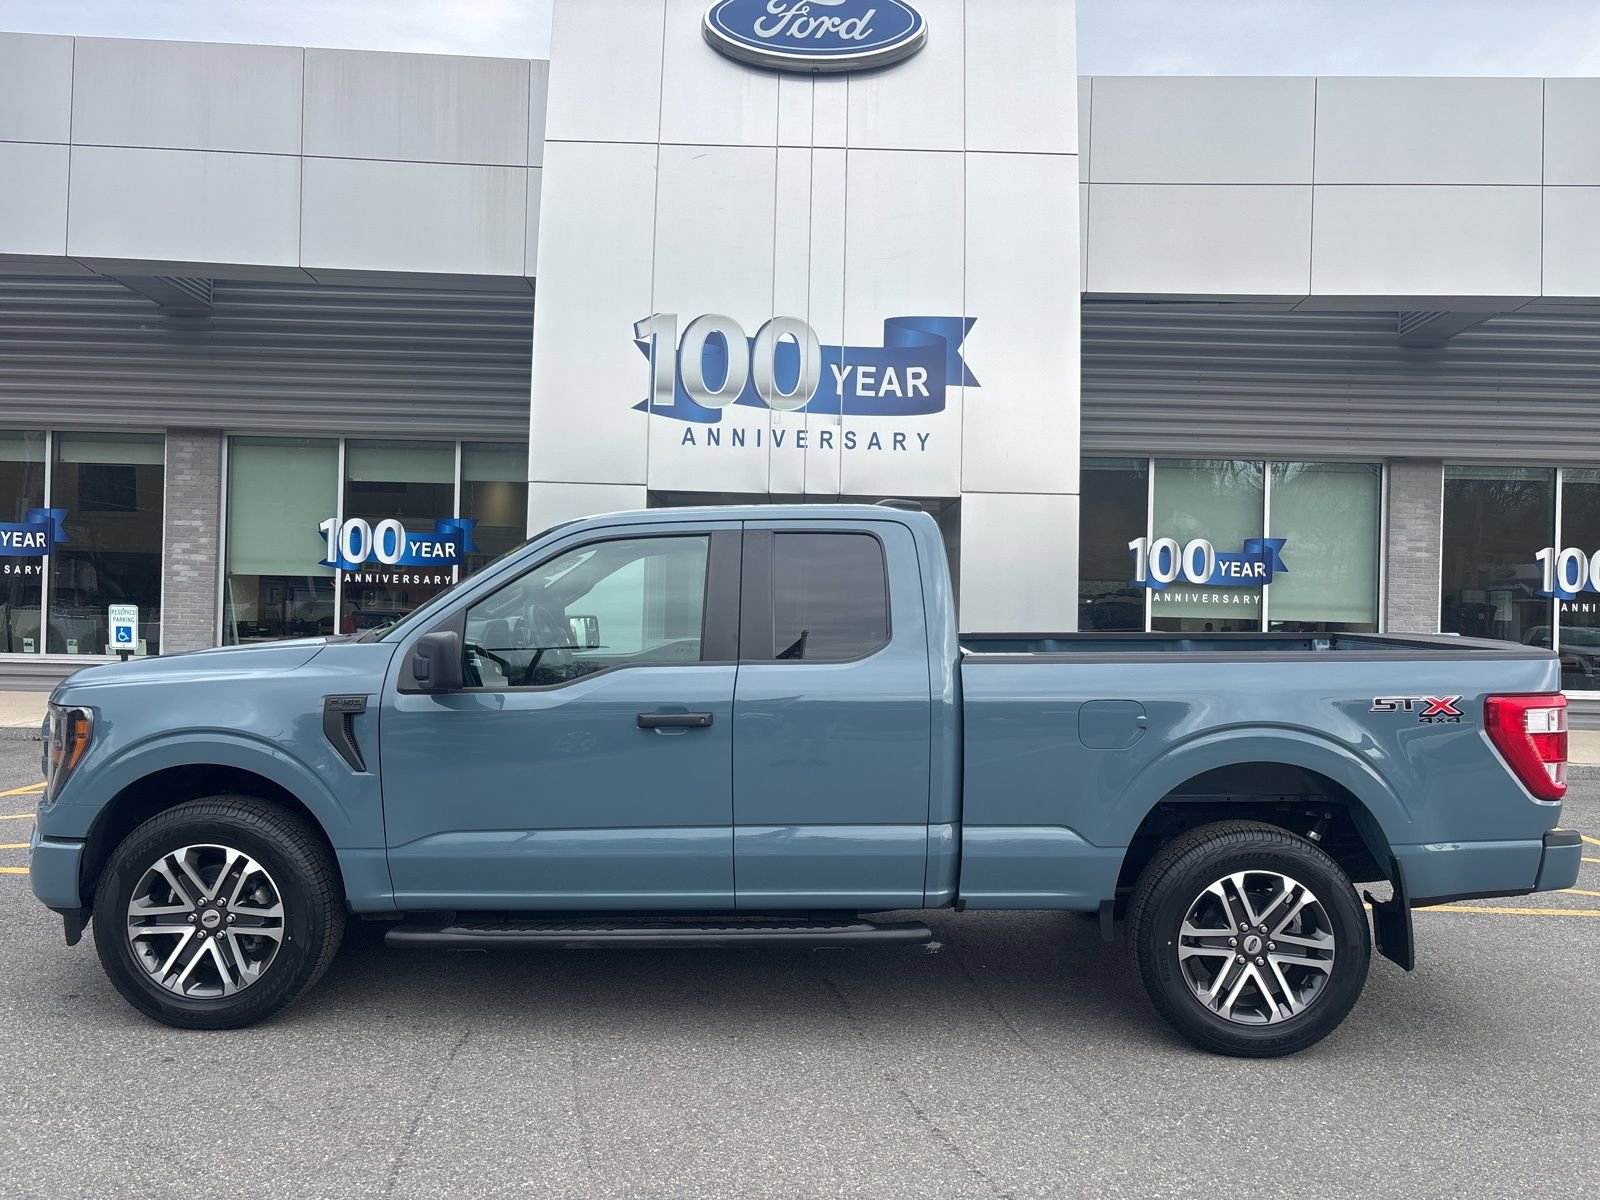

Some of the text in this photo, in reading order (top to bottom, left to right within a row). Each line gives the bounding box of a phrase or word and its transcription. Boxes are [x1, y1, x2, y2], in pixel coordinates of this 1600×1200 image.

[753, 0, 876, 41] Ford
[633, 313, 930, 411] 100 YEAR
[681, 427, 931, 451] ANNIVERSARY
[1, 531, 46, 547] YEAR
[319, 517, 456, 564] 100 YEAR
[1128, 537, 1266, 584] 100 YEAR
[344, 573, 451, 585] ANNIVERSARY
[1153, 592, 1260, 604] ANNIVERSARY
[1561, 602, 1600, 613] ANNI
[111, 608, 136, 616] RESERVED
[1368, 695, 1465, 718] STX
